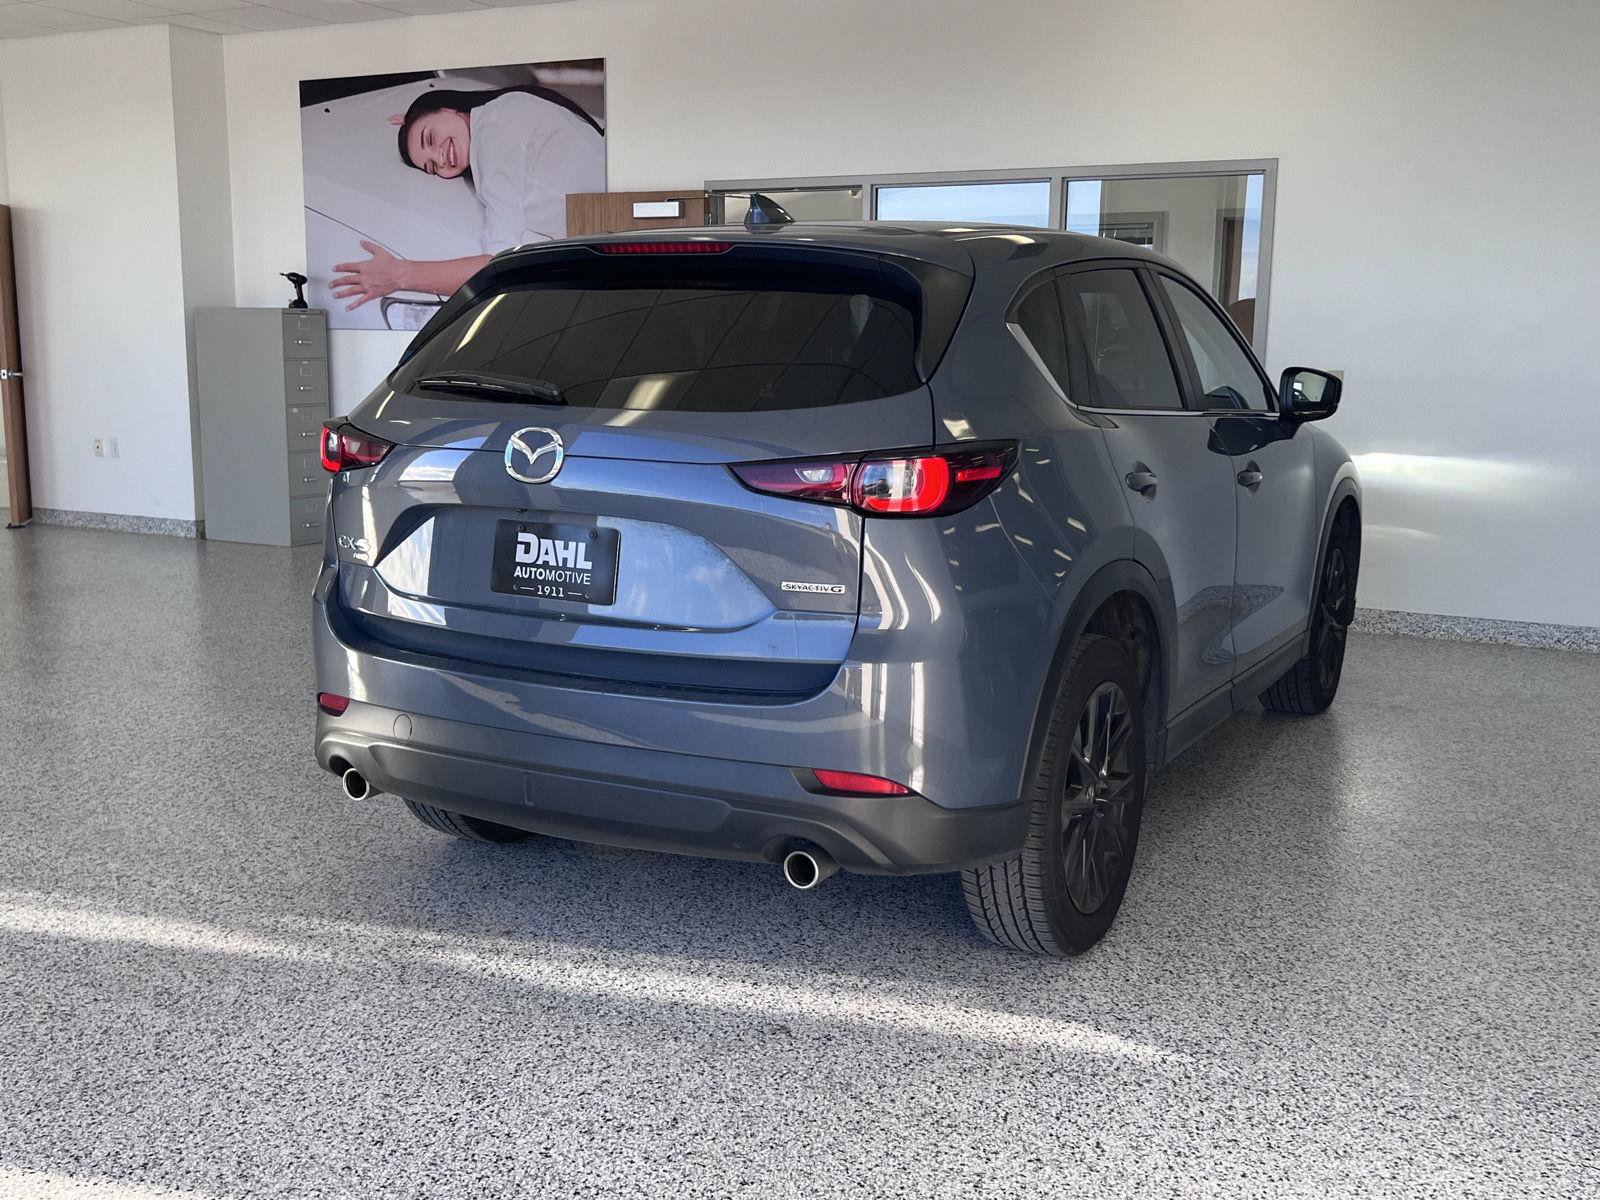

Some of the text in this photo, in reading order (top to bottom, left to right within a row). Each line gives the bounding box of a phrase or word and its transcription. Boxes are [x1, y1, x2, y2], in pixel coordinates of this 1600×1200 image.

[515, 532, 592, 570] DAHL
[514, 566, 591, 585] AUTOMOTIVE
[537, 585, 564, 597] 1911
